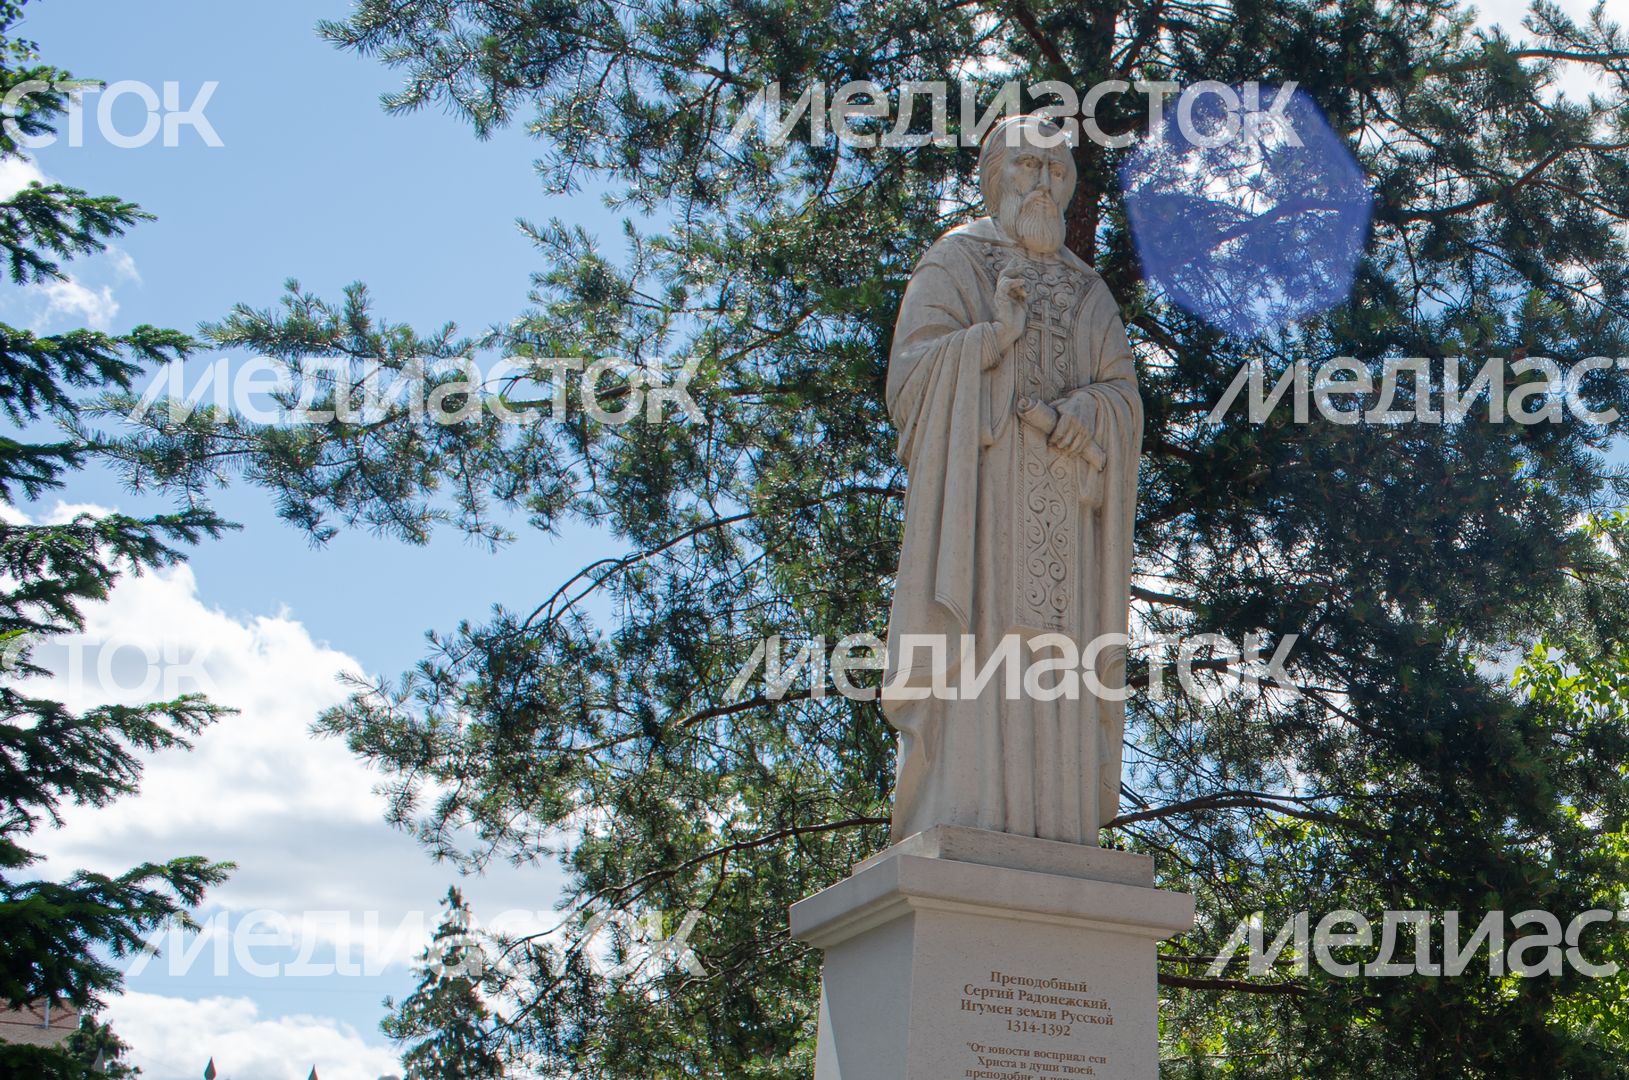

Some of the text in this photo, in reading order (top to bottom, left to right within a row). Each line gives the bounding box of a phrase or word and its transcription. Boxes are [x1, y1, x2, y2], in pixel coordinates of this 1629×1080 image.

[991, 971, 1087, 992] Преподобный
[964, 984, 1013, 999] Сергий
[961, 999, 1113, 1025] Игумен земли Русской
[1007, 1019, 1070, 1036] 1314-1392
[988, 1046, 1030, 1057] юности
[1034, 1051, 1085, 1063] восприял
[1089, 1056, 1106, 1064] еси
[978, 1056, 1016, 1068] Христа
[1030, 1062, 1059, 1072] души
